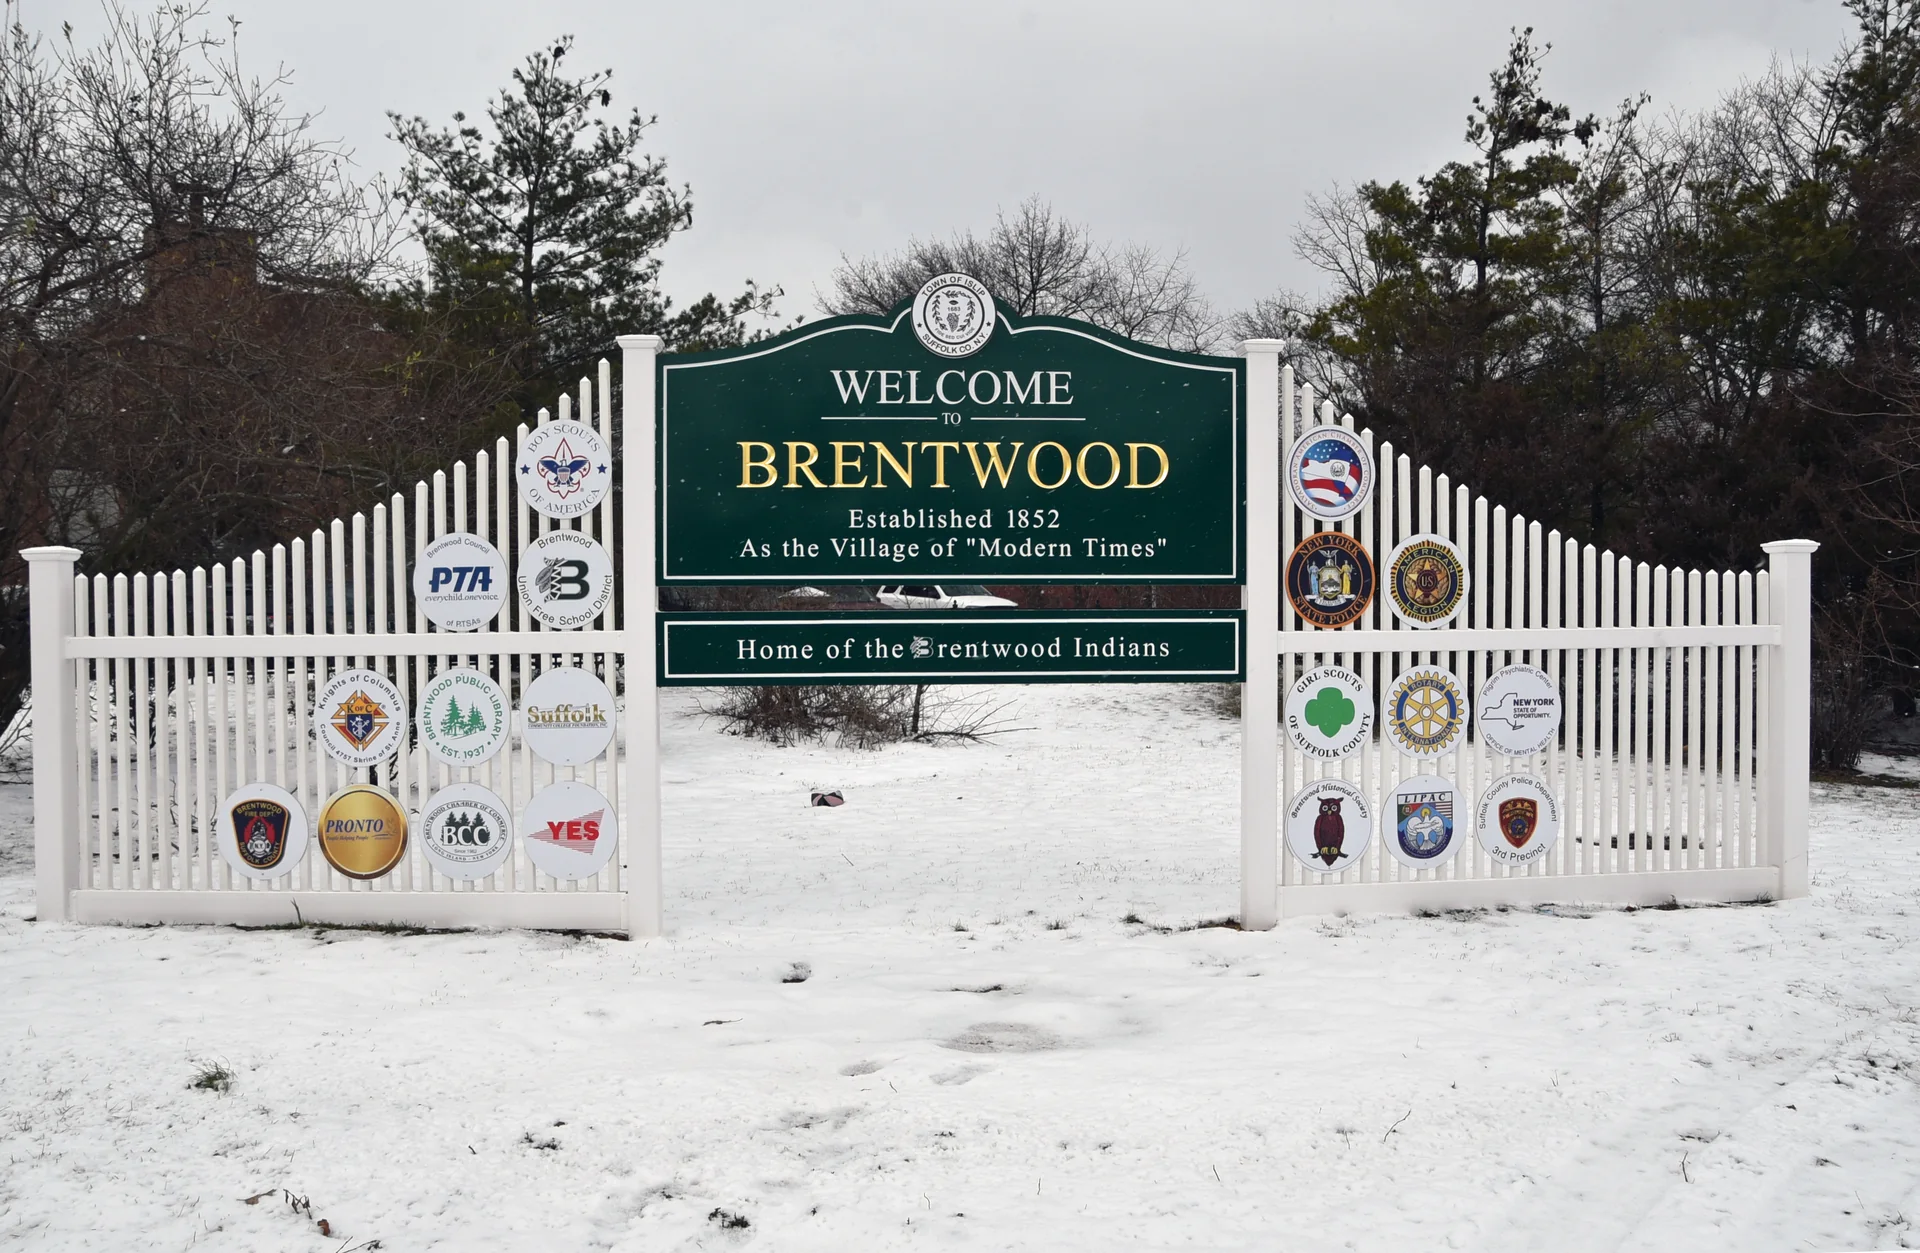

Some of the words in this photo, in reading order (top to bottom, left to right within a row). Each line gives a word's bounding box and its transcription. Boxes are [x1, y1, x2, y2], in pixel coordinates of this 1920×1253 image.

[922, 278, 946, 296] TOWN
[965, 279, 985, 296] ISLIP
[923, 334, 957, 353] SUFFOLK
[959, 345, 974, 353] CO.
[974, 333, 988, 346] N.Y.
[831, 370, 1074, 404] WELCOME
[942, 412, 962, 426] TO
[527, 428, 550, 453] BOY
[554, 424, 600, 453] SCOUTS
[1296, 433, 1327, 459] AMERICAN
[1331, 432, 1362, 453] CHAMBER
[1362, 457, 1367, 465] OF
[736, 440, 1170, 489] BRENTWOOD
[529, 488, 544, 503] OF
[544, 489, 600, 514] AMERICA
[848, 508, 992, 529] Established
[1006, 509, 1060, 529] 1852
[427, 537, 461, 558] Brentwood
[464, 538, 490, 554] Council
[537, 533, 593, 549] Brentwood
[740, 538, 771, 557] As
[782, 537, 819, 557] the
[829, 537, 920, 562] Village
[930, 537, 958, 557] of
[966, 537, 1072, 557] "Modern
[1082, 538, 1167, 557] Times"
[1299, 536, 1324, 557] NEW
[1328, 536, 1360, 557] YORK
[1400, 549, 1455, 573] AMERICAN
[429, 566, 492, 593] PTA
[1421, 576, 1434, 587] US
[518, 575, 533, 606] Union
[533, 605, 555, 623] Free
[559, 608, 594, 625] School
[593, 575, 612, 609] District
[1294, 596, 1325, 623] STATE
[1330, 596, 1367, 624] POLICE
[1407, 601, 1447, 614] LEGION
[737, 639, 813, 659] Home
[826, 638, 855, 658] of
[864, 638, 904, 658] the
[1073, 637, 1170, 657] Indians
[1297, 673, 1321, 693] GIRL
[1324, 669, 1363, 692] SCOUTS
[1411, 681, 1442, 690] ROTARY
[1483, 676, 1500, 696] Pilgrim
[1500, 666, 1534, 677] Psychiatric
[1535, 670, 1552, 689] Center
[319, 679, 346, 709] Knights
[350, 675, 360, 683] of
[364, 675, 401, 712] Columbus
[347, 705, 353, 713] K
[365, 705, 372, 713] C
[424, 679, 452, 740] BRENTWOOD
[456, 676, 491, 694] PUBLIC
[489, 694, 502, 740] LIBRARY
[528, 703, 606, 723] Suffolk
[320, 724, 336, 751] Council
[336, 751, 351, 761] 4757
[385, 743, 393, 751] St.
[392, 722, 400, 741] Anne
[1289, 715, 1299, 730] OF
[1295, 732, 1340, 757] SUFFOLK
[1342, 713, 1371, 753] COUNTY
[1400, 725, 1453, 744] INTERNATIONAL
[1486, 733, 1503, 751] OFFICE
[1514, 746, 1537, 755] MENTAL
[1537, 728, 1555, 748] HEALTH
[441, 745, 460, 759] EST.
[464, 745, 485, 759] 1937
[236, 803, 282, 814] BRENTWOOD
[1291, 785, 1320, 818] Brentwood
[1321, 784, 1356, 797] Historical
[1352, 792, 1368, 819] Society
[1404, 793, 1445, 803] LIPAC
[1480, 803, 1489, 829] Suffolk
[1486, 780, 1509, 800] County
[1511, 777, 1533, 785] Police
[1534, 781, 1557, 822] Department
[326, 819, 383, 832] PRONTO
[426, 806, 446, 839] BRENTWOOD
[447, 801, 478, 809] CHAMBER
[547, 821, 599, 840] YES
[442, 826, 488, 846] BCC
[240, 842, 259, 864] SUFFOLK
[263, 842, 280, 863] COUNTY
[1492, 846, 1507, 859] 3rd
[1510, 843, 1546, 862] Precinct
